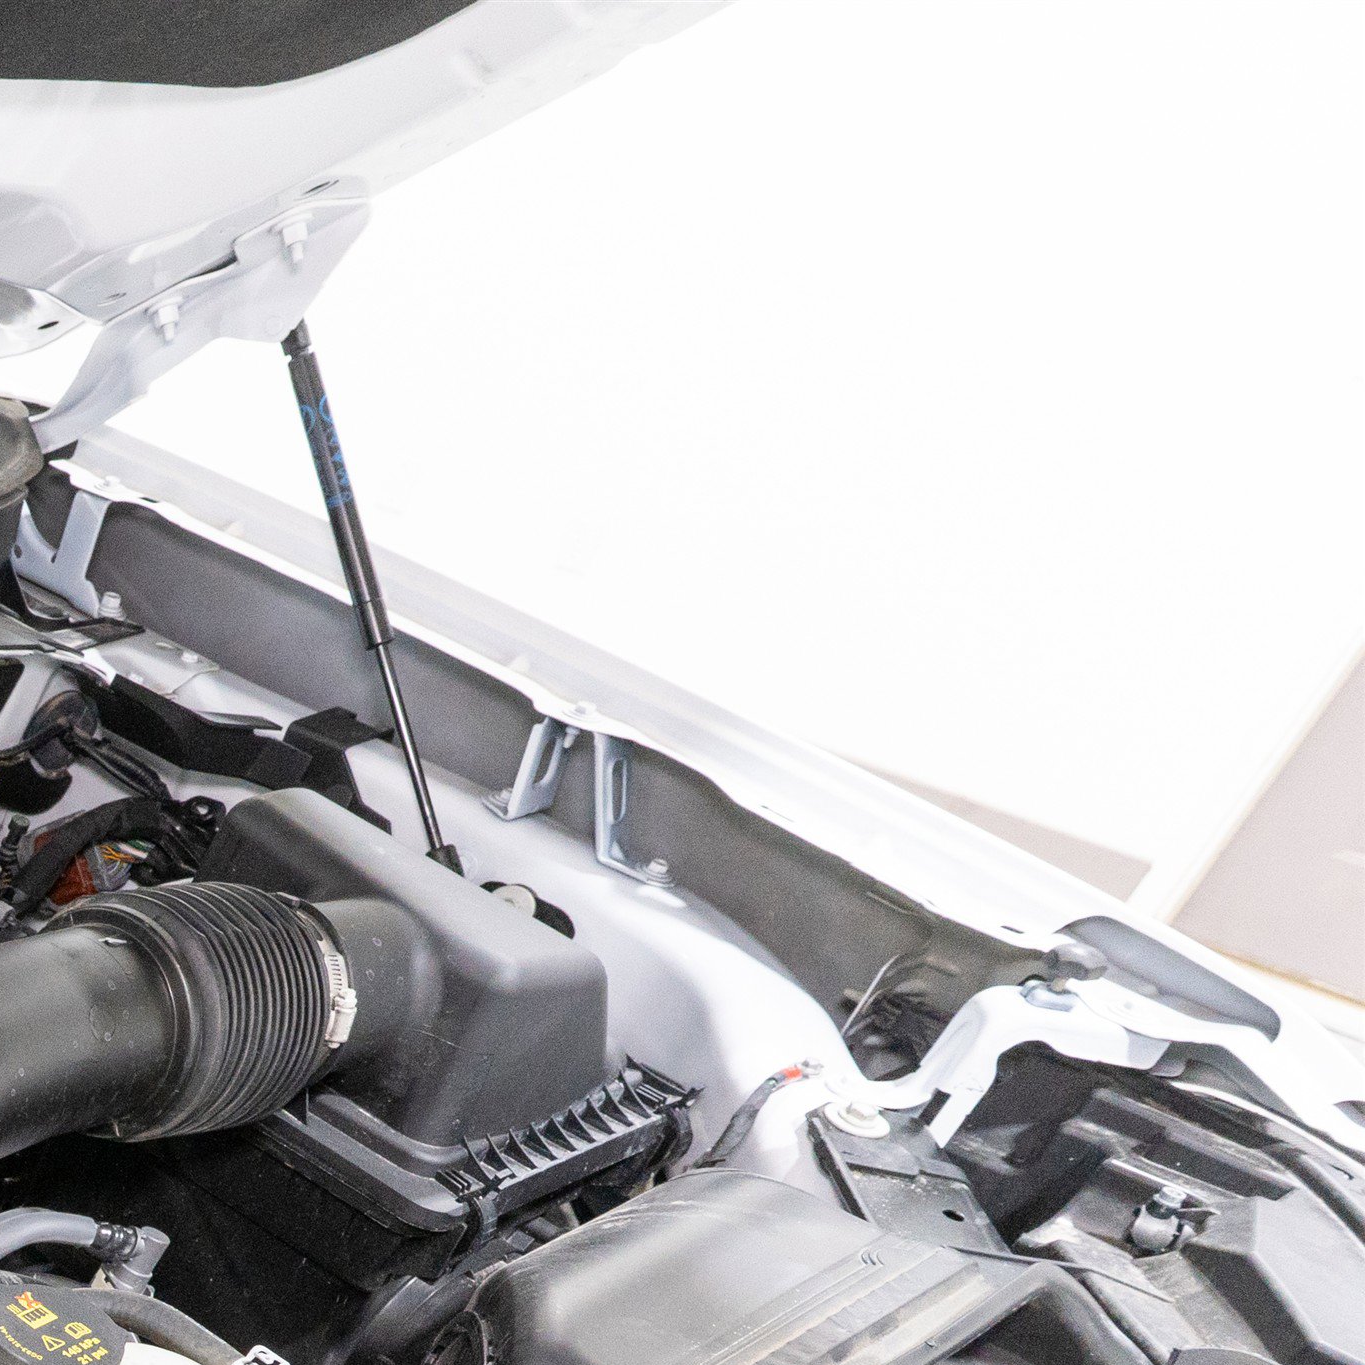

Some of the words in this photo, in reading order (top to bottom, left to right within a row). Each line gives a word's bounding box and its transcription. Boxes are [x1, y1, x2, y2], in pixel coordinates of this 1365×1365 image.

[62, 1343, 83, 1358] 145
[83, 1336, 101, 1350] kPa
[77, 1354, 93, 1365] 21
